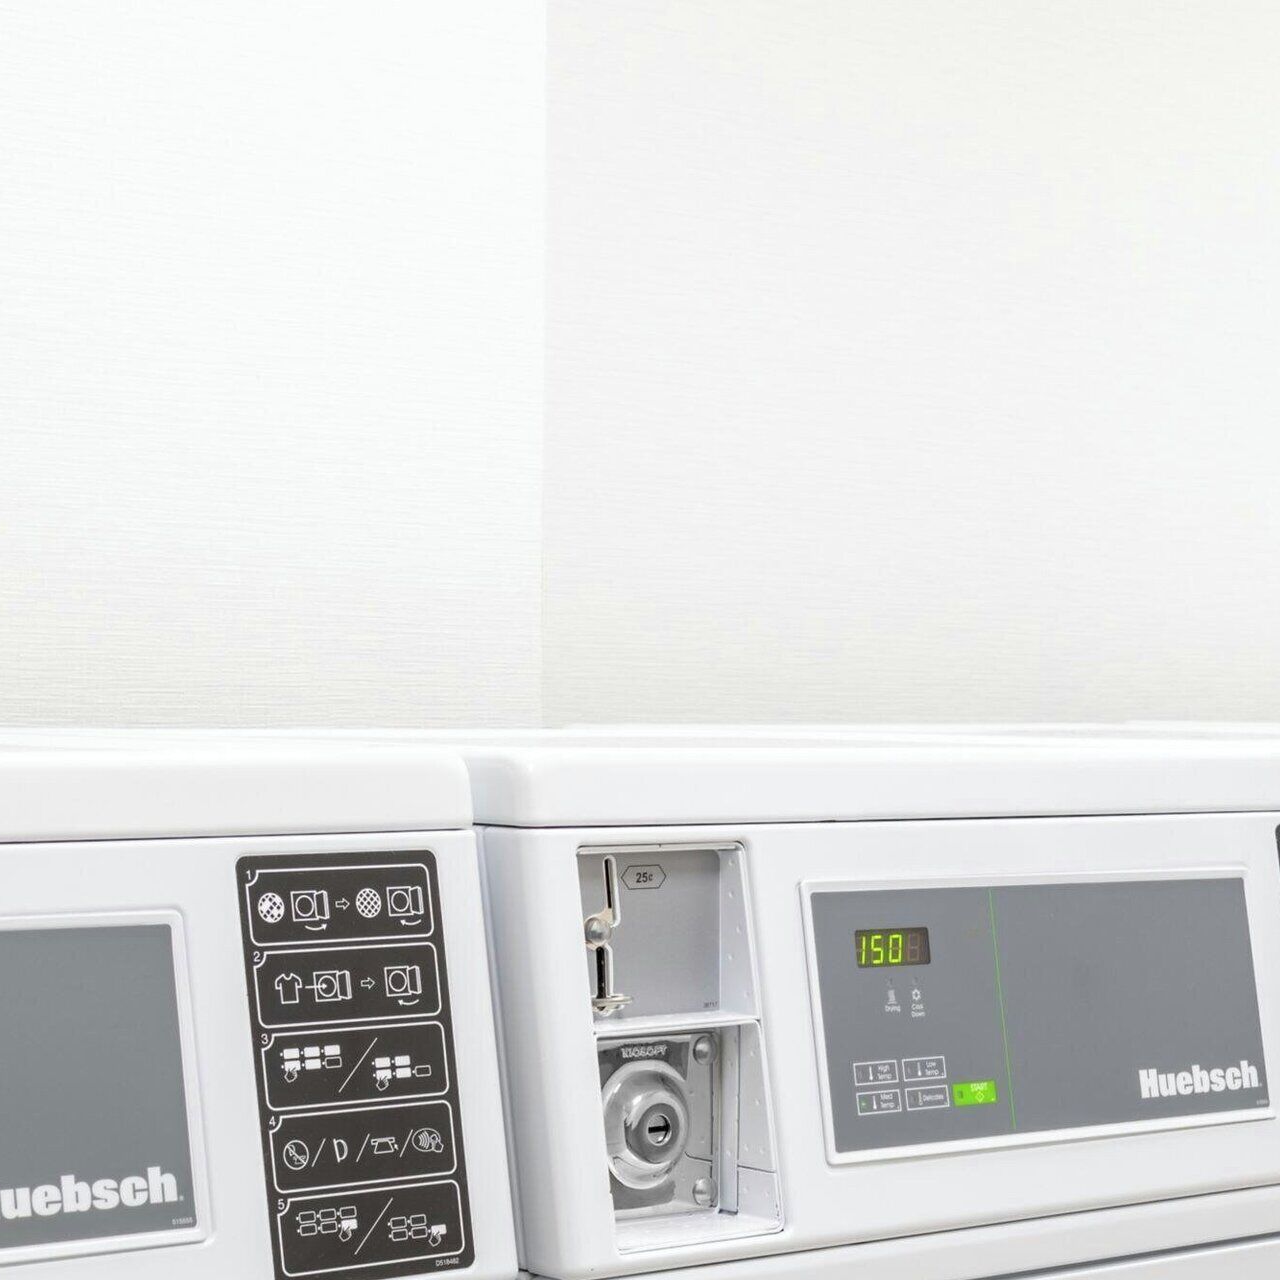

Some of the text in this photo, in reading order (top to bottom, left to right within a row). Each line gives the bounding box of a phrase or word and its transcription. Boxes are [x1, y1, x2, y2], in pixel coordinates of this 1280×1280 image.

[246, 869, 251, 880] 1
[861, 934, 902, 965] 150
[253, 951, 261, 962] 2
[261, 1033, 269, 1045] 3
[1138, 1060, 1259, 1099] Huebsch
[269, 1115, 276, 1127] 4
[277, 1199, 285, 1211] 5
